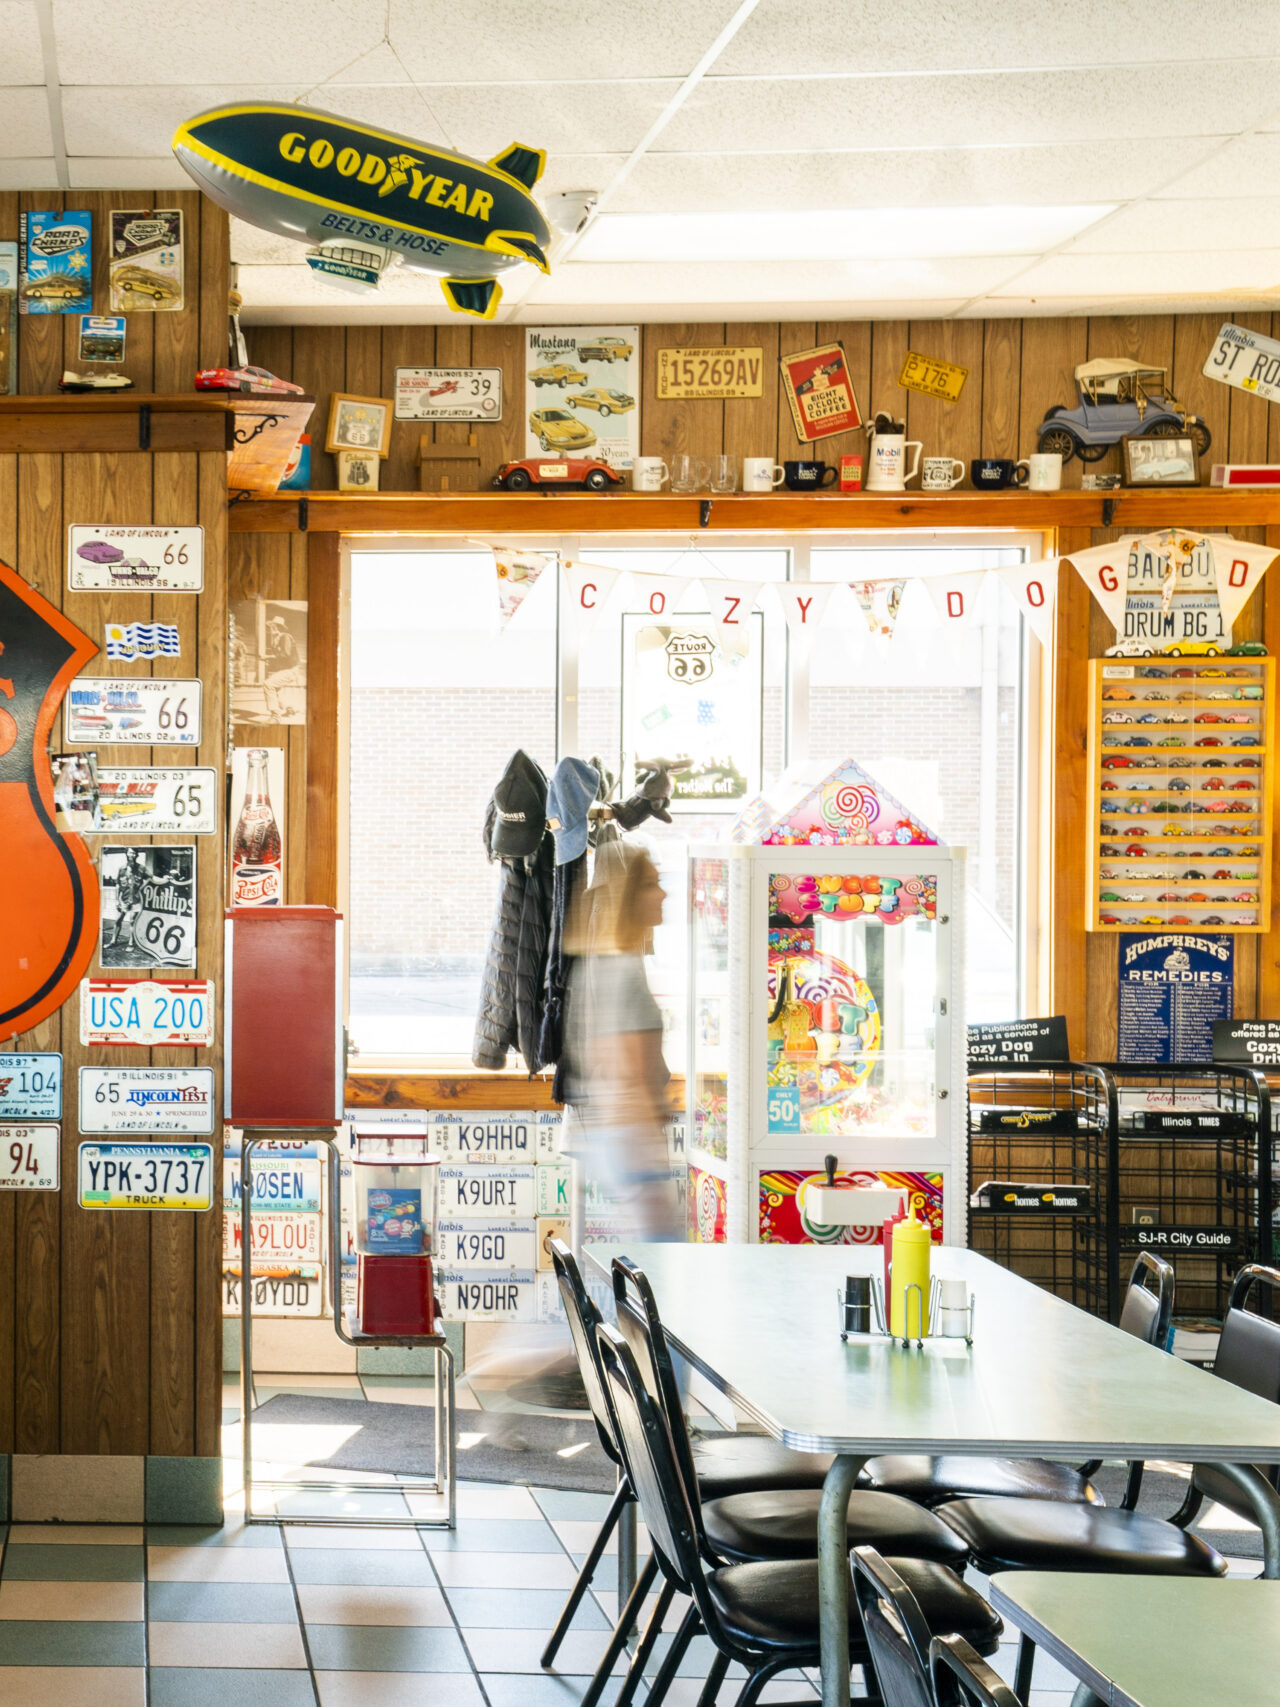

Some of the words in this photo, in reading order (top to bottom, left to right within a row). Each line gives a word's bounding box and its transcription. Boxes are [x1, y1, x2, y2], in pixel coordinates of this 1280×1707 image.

[279, 132, 493, 222] GOODYEAR
[44, 231, 80, 239] ROAD
[321, 212, 379, 240] BELTS
[378, 228, 394, 243] &
[395, 233, 450, 256] HOSE
[529, 333, 577, 350] Mustang
[1222, 328, 1256, 348] Illinois
[670, 358, 761, 388] 15269AV
[1214, 340, 1246, 372] ST
[1249, 352, 1280, 387] RO
[470, 379, 491, 396] 39
[921, 367, 949, 388] 176
[811, 390, 837, 402] EIGHT
[809, 403, 847, 419] COFFEE
[876, 448, 901, 457] Mobil
[163, 544, 189, 565] 66
[1124, 612, 1174, 637] DRUM
[1183, 611, 1208, 637] BG
[159, 697, 188, 730] 66
[131, 772, 167, 780] ILLINOIS
[173, 785, 202, 817] 65
[793, 875, 902, 896] SWEET
[143, 885, 193, 916] Phillips
[799, 893, 900, 914] STUFF
[145, 916, 186, 955] 66
[1129, 970, 1223, 982] REMEDIES
[91, 997, 140, 1028] USA
[153, 998, 204, 1029] 200
[981, 1022, 1038, 1034] Publications
[1004, 1030, 1038, 1039] service
[1040, 1027, 1050, 1036] of
[1231, 1030, 1266, 1038] offered
[1243, 1023, 1265, 1031] Free
[1001, 1040, 1034, 1055] Dog
[18, 1071, 56, 1093] 104
[95, 1083, 119, 1103] 65
[435, 1113, 463, 1123] Illinois
[1162, 1117, 1192, 1127] Illinois
[1198, 1117, 1220, 1127] TIMES
[459, 1126, 527, 1150] K9HHQ
[10, 1142, 39, 1175] 94
[111, 1146, 181, 1156] PENNSYLVANIA
[88, 1160, 205, 1194] YPK-3737
[126, 1195, 166, 1204] TRUCK
[457, 1180, 517, 1205] K9URI
[1014, 1195, 1040, 1207] homes
[1053, 1195, 1078, 1207] homes
[1138, 1232, 1168, 1244] SJ-R
[1170, 1232, 1193, 1246] City
[1196, 1232, 1231, 1244] Guide
